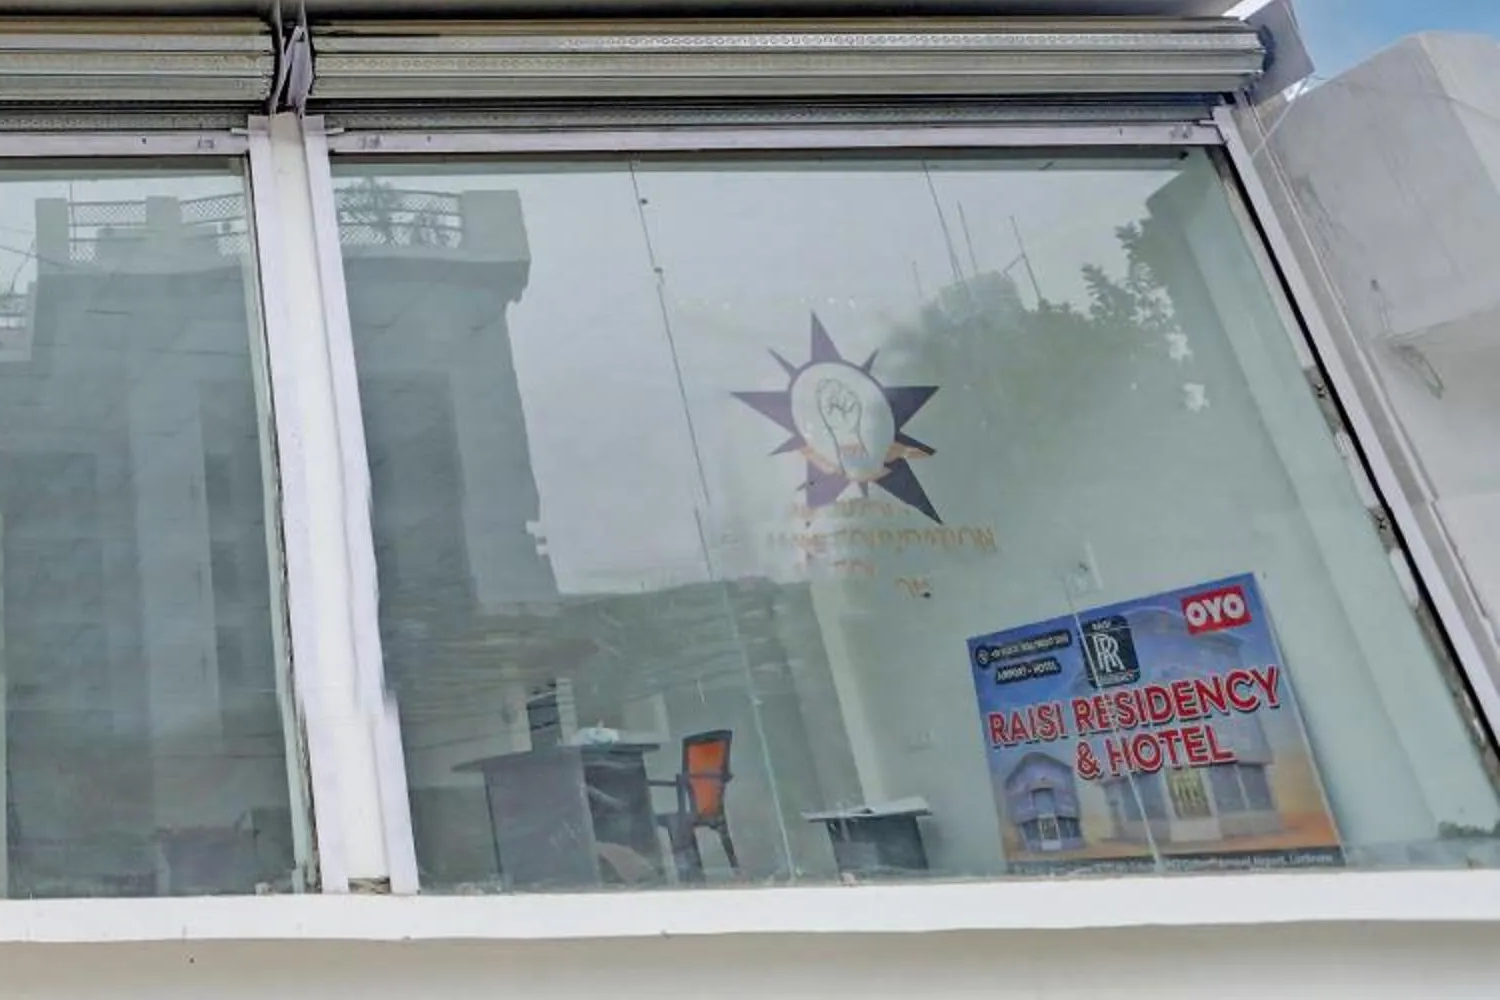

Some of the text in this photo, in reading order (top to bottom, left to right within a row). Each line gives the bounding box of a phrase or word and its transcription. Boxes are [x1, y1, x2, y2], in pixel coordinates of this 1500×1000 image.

[1185, 594, 1246, 628] OYO
[987, 665, 1282, 748] RAISI RESIDENCY
[1075, 724, 1238, 781] & HOTEL
